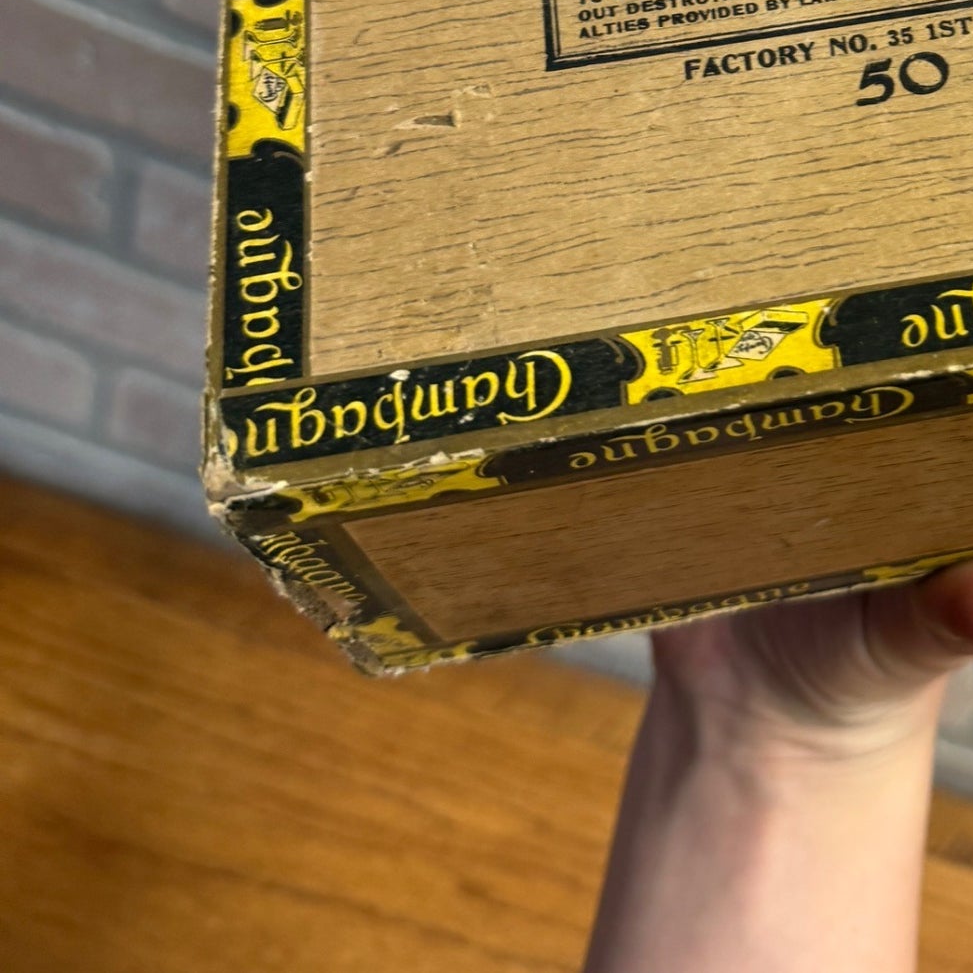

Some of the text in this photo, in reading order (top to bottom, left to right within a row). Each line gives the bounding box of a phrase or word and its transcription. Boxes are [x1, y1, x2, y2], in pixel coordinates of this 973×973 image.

[577, 5, 619, 22] OUT
[579, 17, 650, 39] ALTIES
[657, 2, 759, 28] PROVIDED
[684, 41, 815, 81] FACTORY
[829, 34, 878, 57] NO.
[887, 26, 914, 47] 35
[925, 16, 973, 41] 1ST
[855, 51, 950, 107] 50
[568, 385, 915, 471] Champagne
